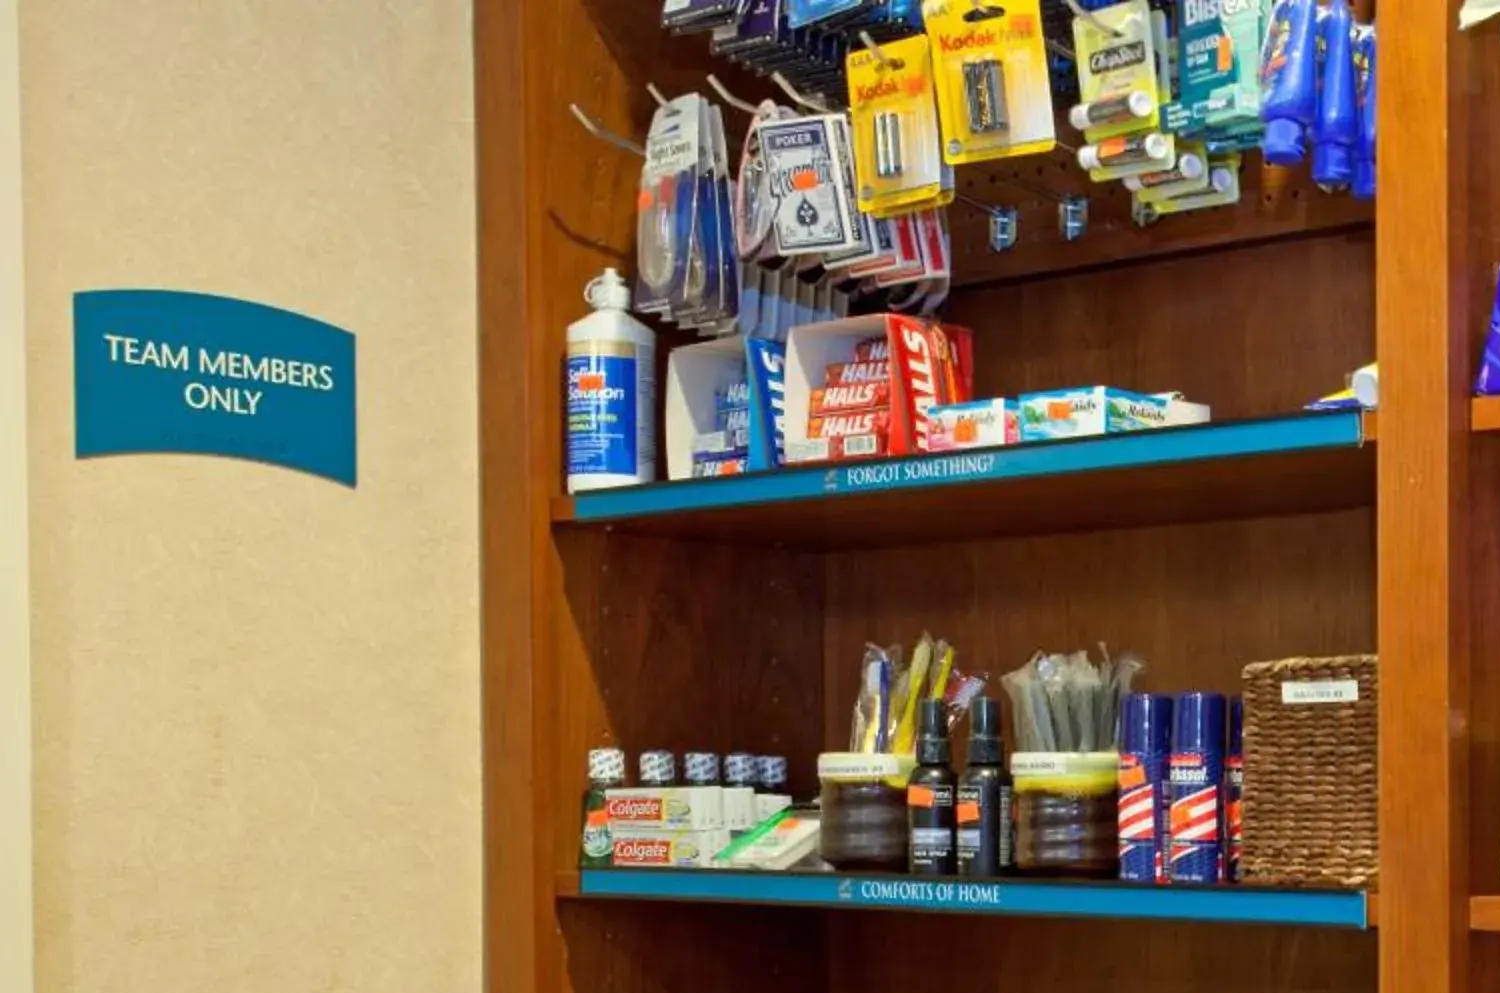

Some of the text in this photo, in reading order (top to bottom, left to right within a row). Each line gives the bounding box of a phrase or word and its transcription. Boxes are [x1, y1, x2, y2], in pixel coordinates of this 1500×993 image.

[939, 28, 995, 51] Kodak
[856, 79, 900, 101] Kodak
[774, 132, 813, 148] POKER
[102, 333, 334, 391] TEAM MEMBERS
[184, 381, 263, 416] ONLY
[822, 384, 876, 409] HALLS
[820, 413, 875, 438] HALLS
[847, 454, 996, 487] FORGOT SOMETHING?
[609, 801, 660, 819] Colgate
[614, 842, 668, 860] Colgate
[861, 880, 1000, 904] COMFORTS OF HOME
